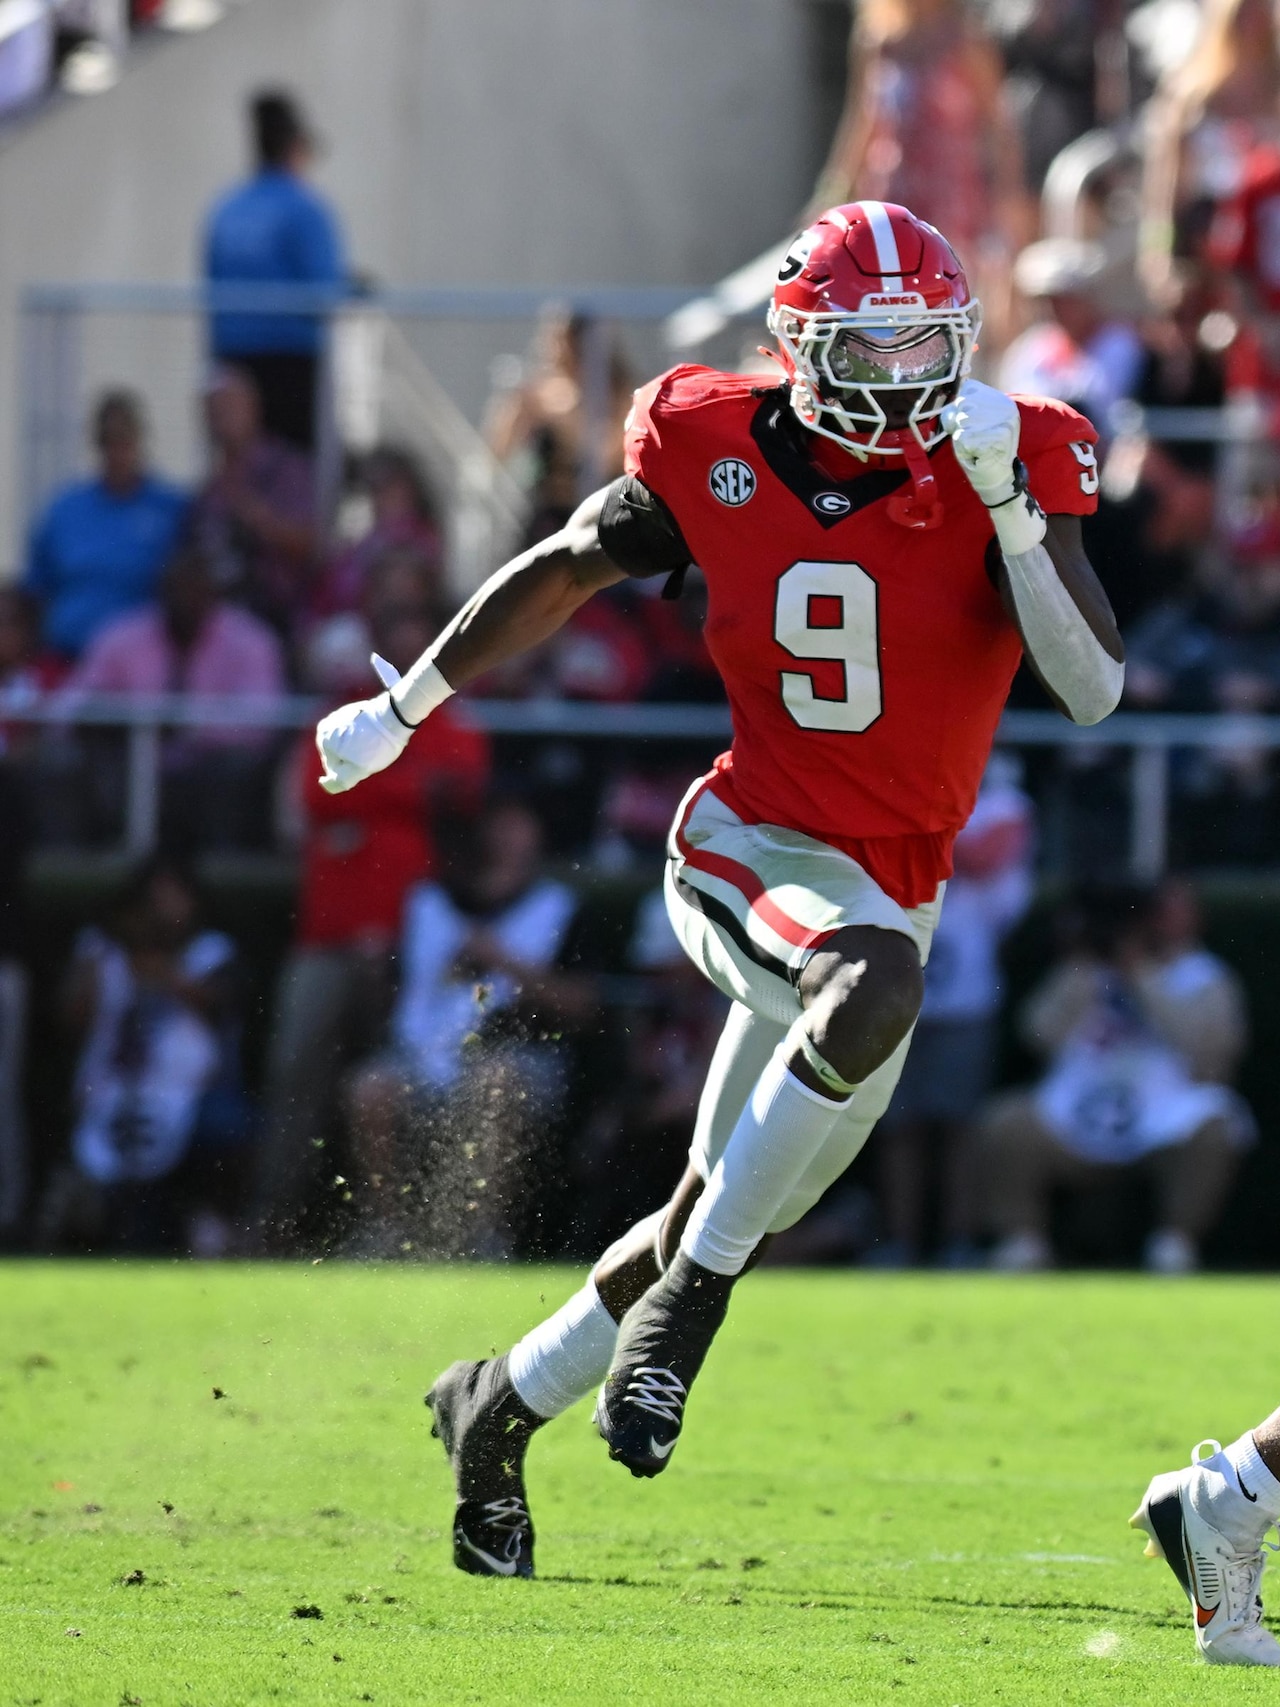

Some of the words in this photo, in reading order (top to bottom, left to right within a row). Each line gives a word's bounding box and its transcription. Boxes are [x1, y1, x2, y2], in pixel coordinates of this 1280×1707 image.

[869, 295, 919, 306] DAWGS
[711, 460, 755, 503] SEC
[1068, 441, 1099, 495] 9
[818, 494, 851, 513] G
[773, 558, 884, 735] 9
